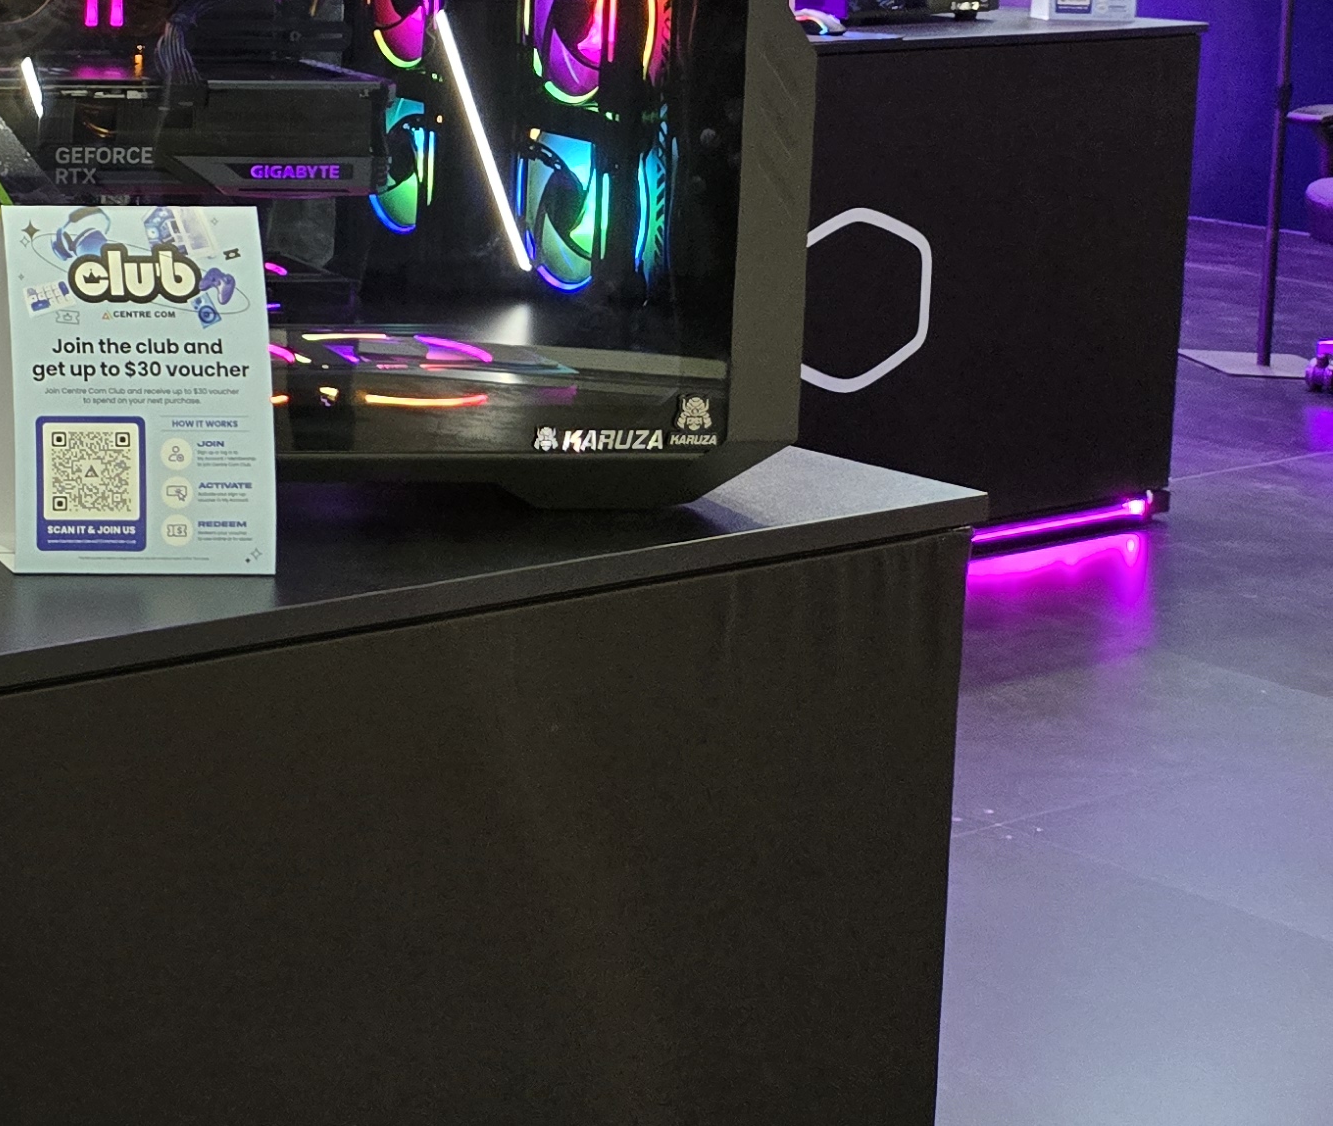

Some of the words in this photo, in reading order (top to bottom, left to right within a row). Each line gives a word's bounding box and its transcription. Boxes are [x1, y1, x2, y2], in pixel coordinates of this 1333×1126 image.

[55, 147, 153, 165] GEFORCE
[55, 168, 96, 185] RTX
[250, 165, 340, 180] GIGABYTE
[75, 250, 195, 297] club
[113, 310, 152, 319] CENTRE
[154, 310, 176, 319] COM
[51, 338, 94, 355] Join
[98, 338, 132, 355] the
[135, 338, 179, 355] club
[182, 338, 223, 355] and
[32, 362, 66, 382] get
[70, 364, 96, 382] up
[100, 363, 120, 377] to
[124, 360, 162, 379] $30
[166, 361, 250, 378] voucher
[171, 420, 194, 428] HOW
[195, 420, 203, 428] IT
[204, 420, 238, 428] WORKS
[196, 440, 225, 448] JOIN
[561, 428, 664, 452] KARUZA
[670, 433, 717, 445] KARUZA
[197, 482, 252, 490] ACTIVATE
[47, 525, 74, 534] SCAN
[76, 525, 87, 534] IT
[88, 525, 96, 534] &
[97, 525, 121, 534] JOIN
[122, 525, 136, 534] US
[197, 520, 247, 528] REDEEM
